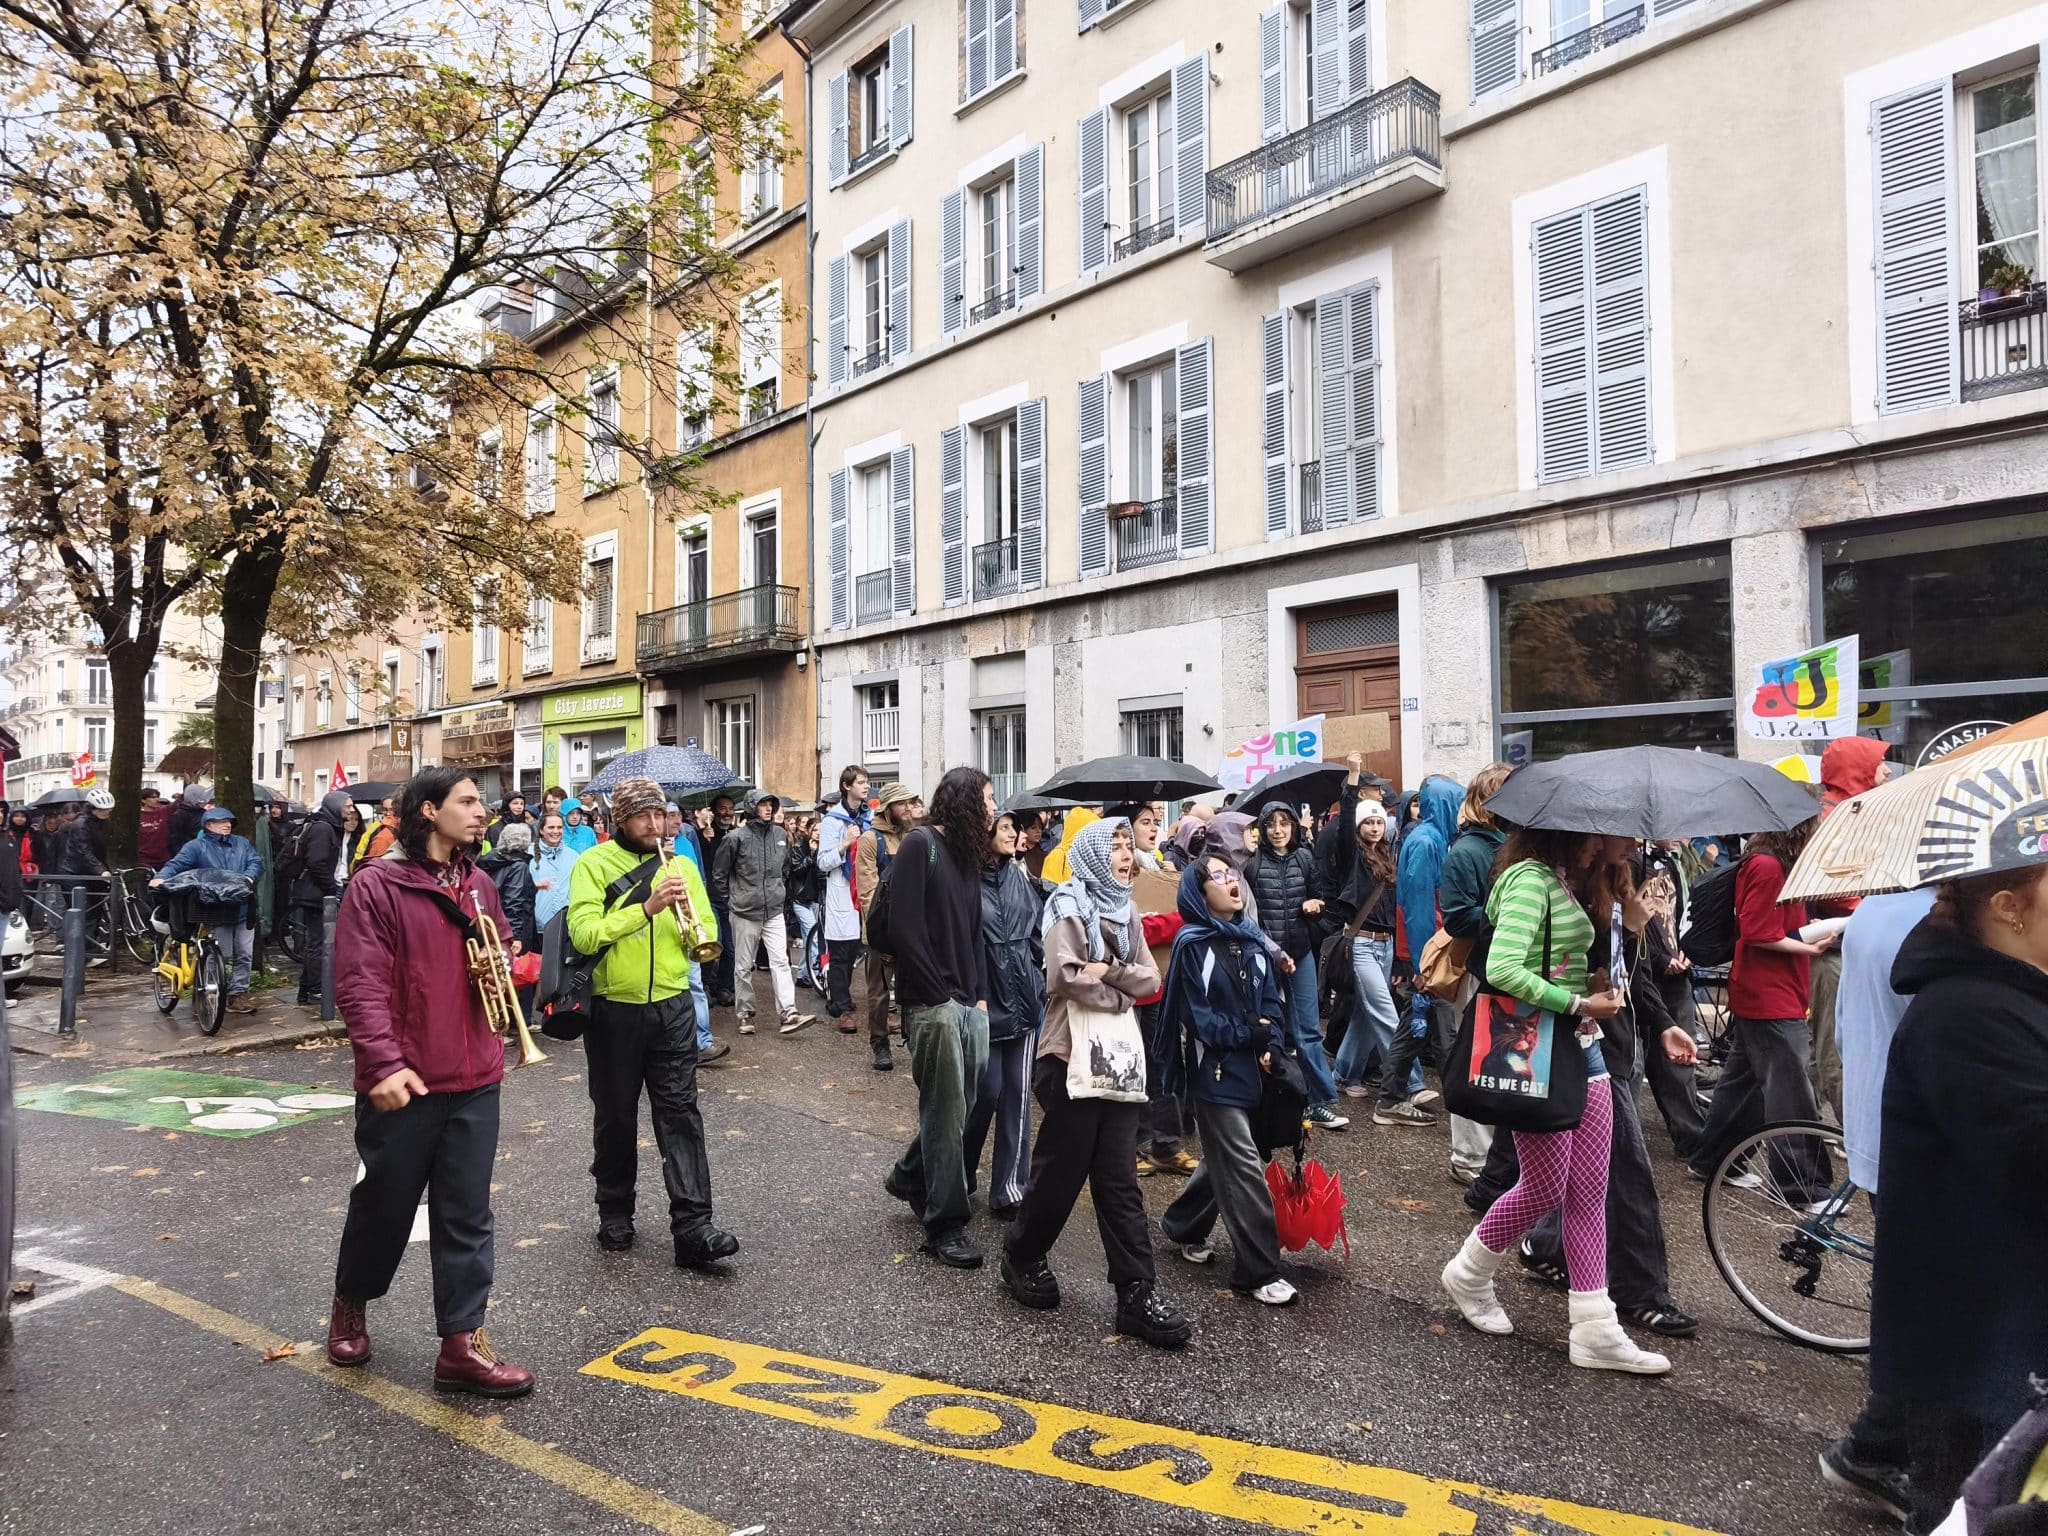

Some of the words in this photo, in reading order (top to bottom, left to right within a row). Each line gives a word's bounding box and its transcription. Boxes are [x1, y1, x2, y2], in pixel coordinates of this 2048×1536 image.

[554, 698, 578, 716] City
[582, 691, 625, 713] laverie
[1404, 698, 1417, 709] 29
[1929, 727, 1988, 761] SMASH
[1473, 1074, 1495, 1089] YES
[1499, 1078, 1517, 1091] WE
[1521, 1081, 1545, 1094] CAT
